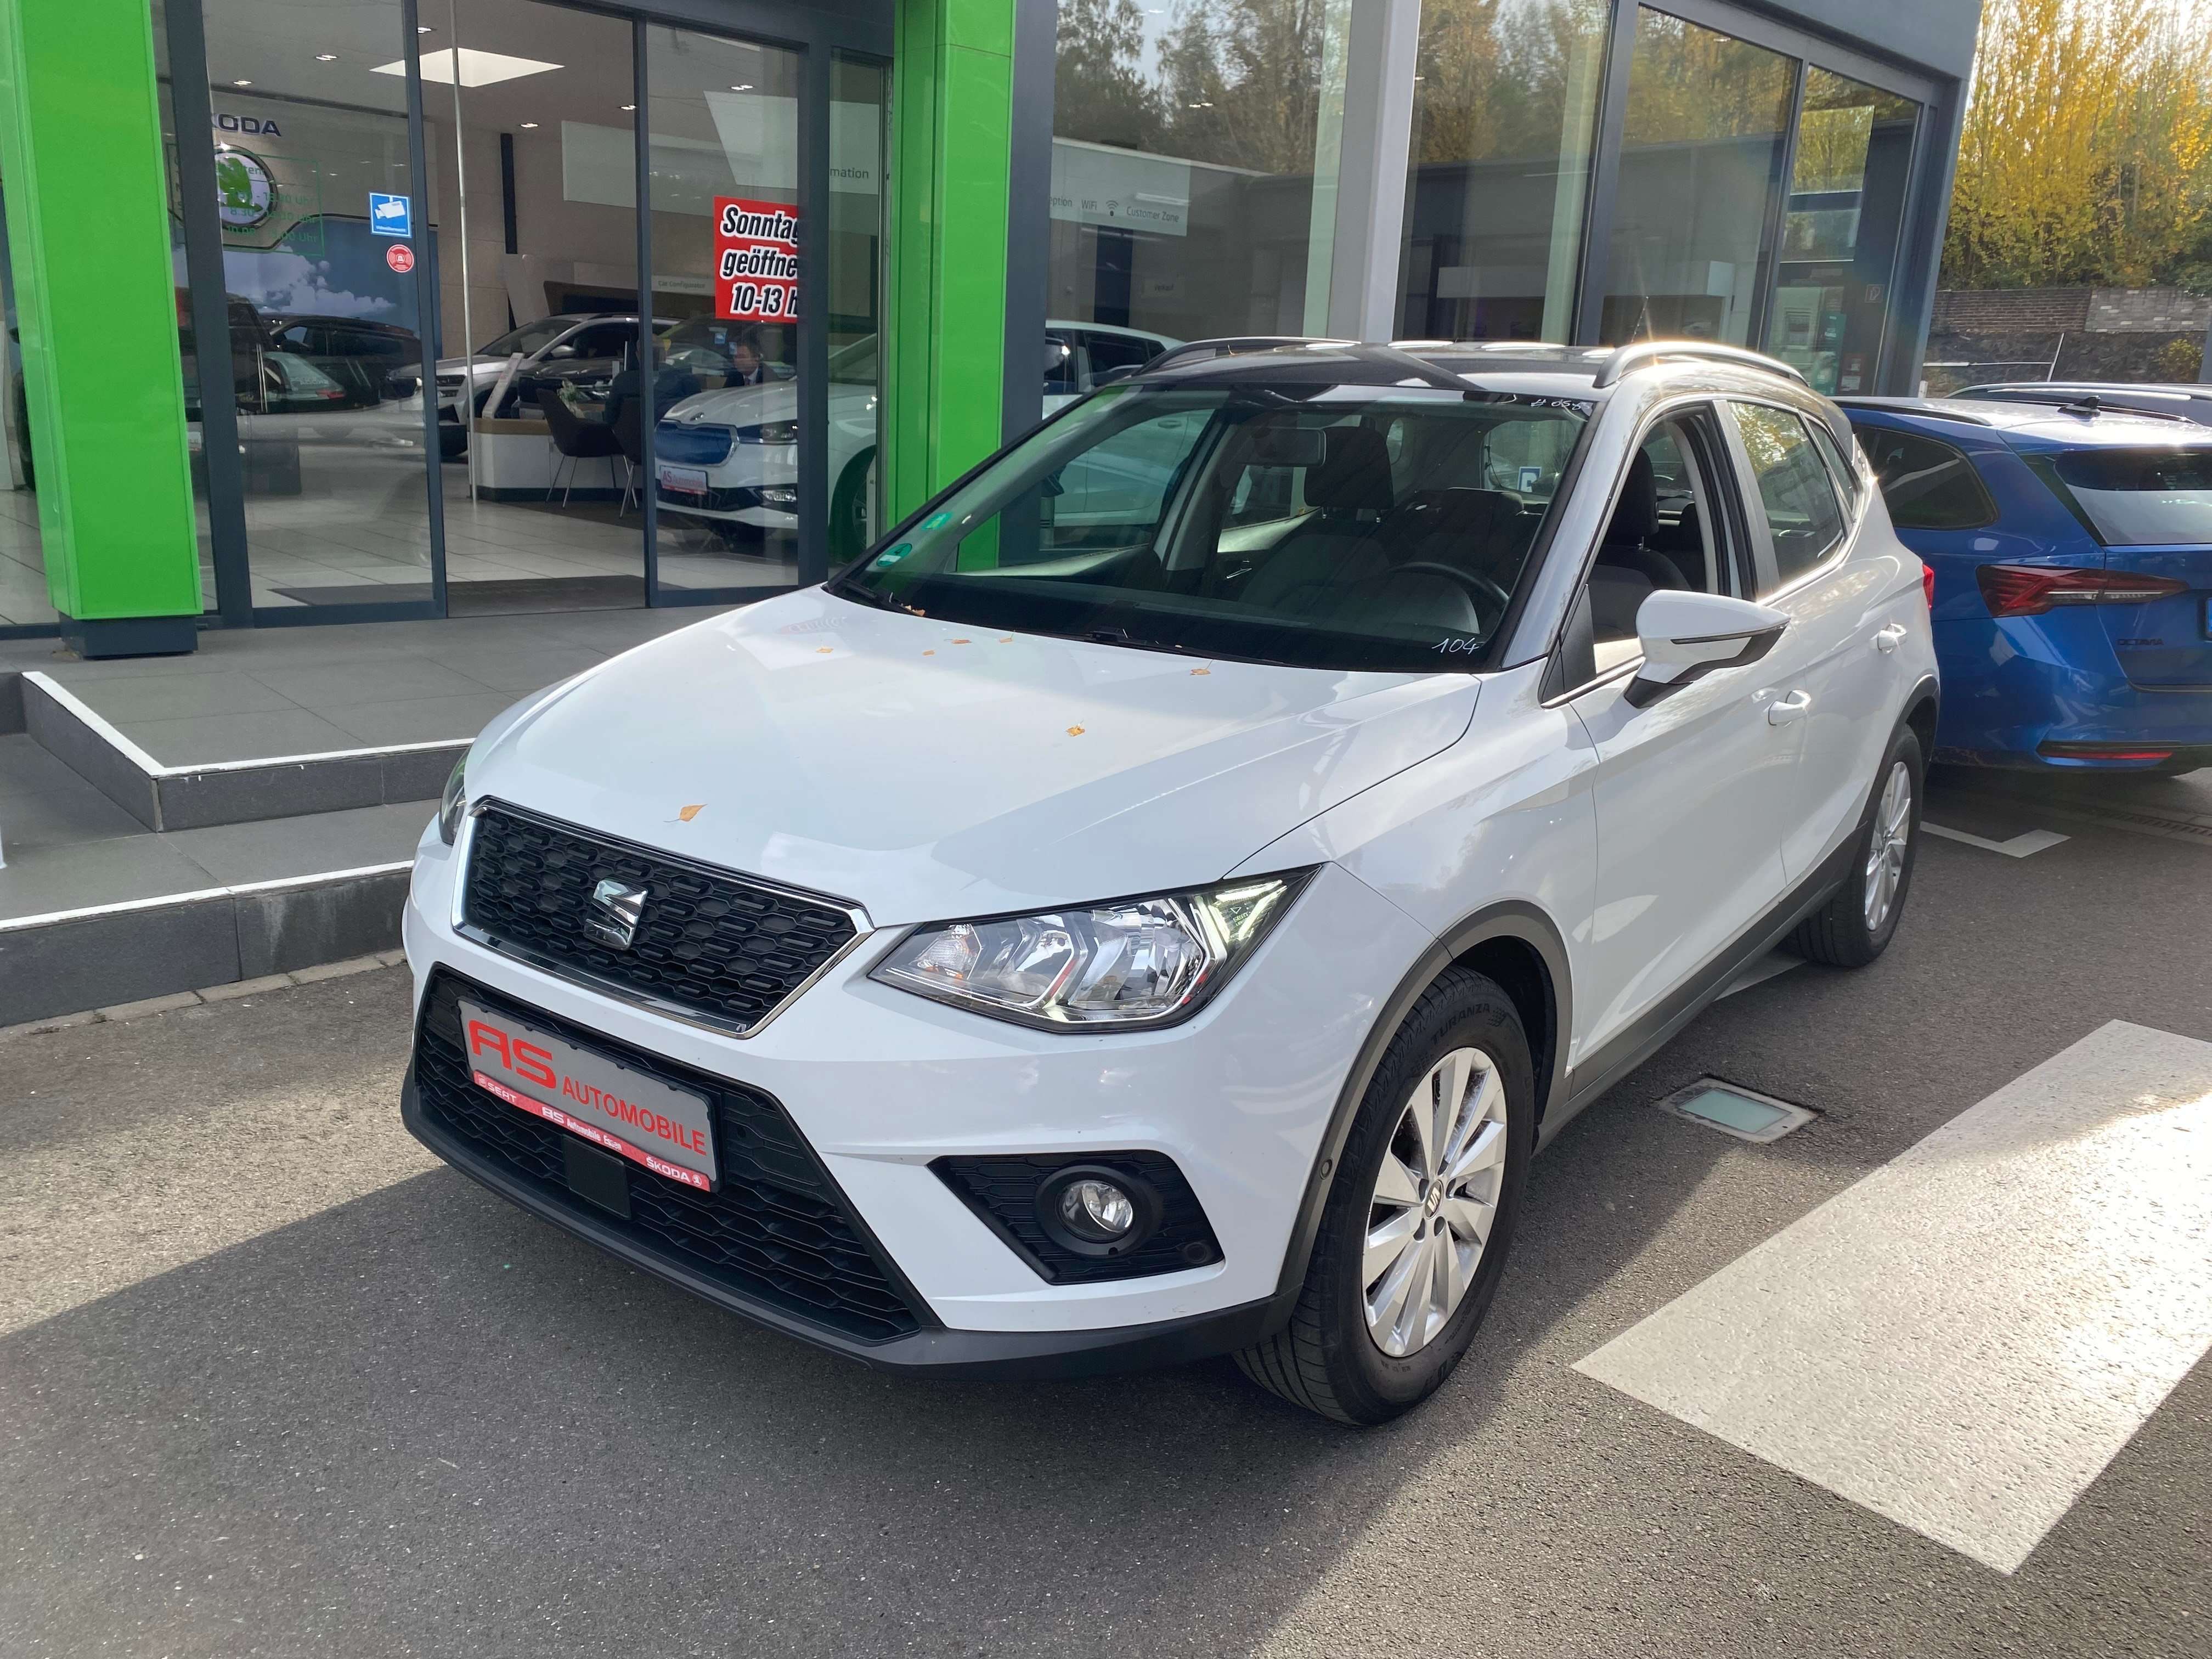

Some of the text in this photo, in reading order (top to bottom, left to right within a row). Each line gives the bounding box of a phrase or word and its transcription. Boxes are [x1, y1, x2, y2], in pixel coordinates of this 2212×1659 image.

[218, 114, 281, 137] ODA
[830, 167, 869, 179] mation
[1081, 199, 1097, 210] WiFi
[1126, 206, 1180, 222] Customer Zone
[722, 249, 798, 277] geöffne
[733, 285, 783, 314] 10-13
[1431, 637, 1480, 654] 104
[1432, 1003, 1491, 1043] TURANZA
[469, 1020, 556, 1089] AS
[487, 1082, 517, 1104] SEAT
[562, 1076, 707, 1156] AUTOMOBILE
[566, 1118, 601, 1142] Automobile
[646, 1155, 691, 1183] ŠKODA
